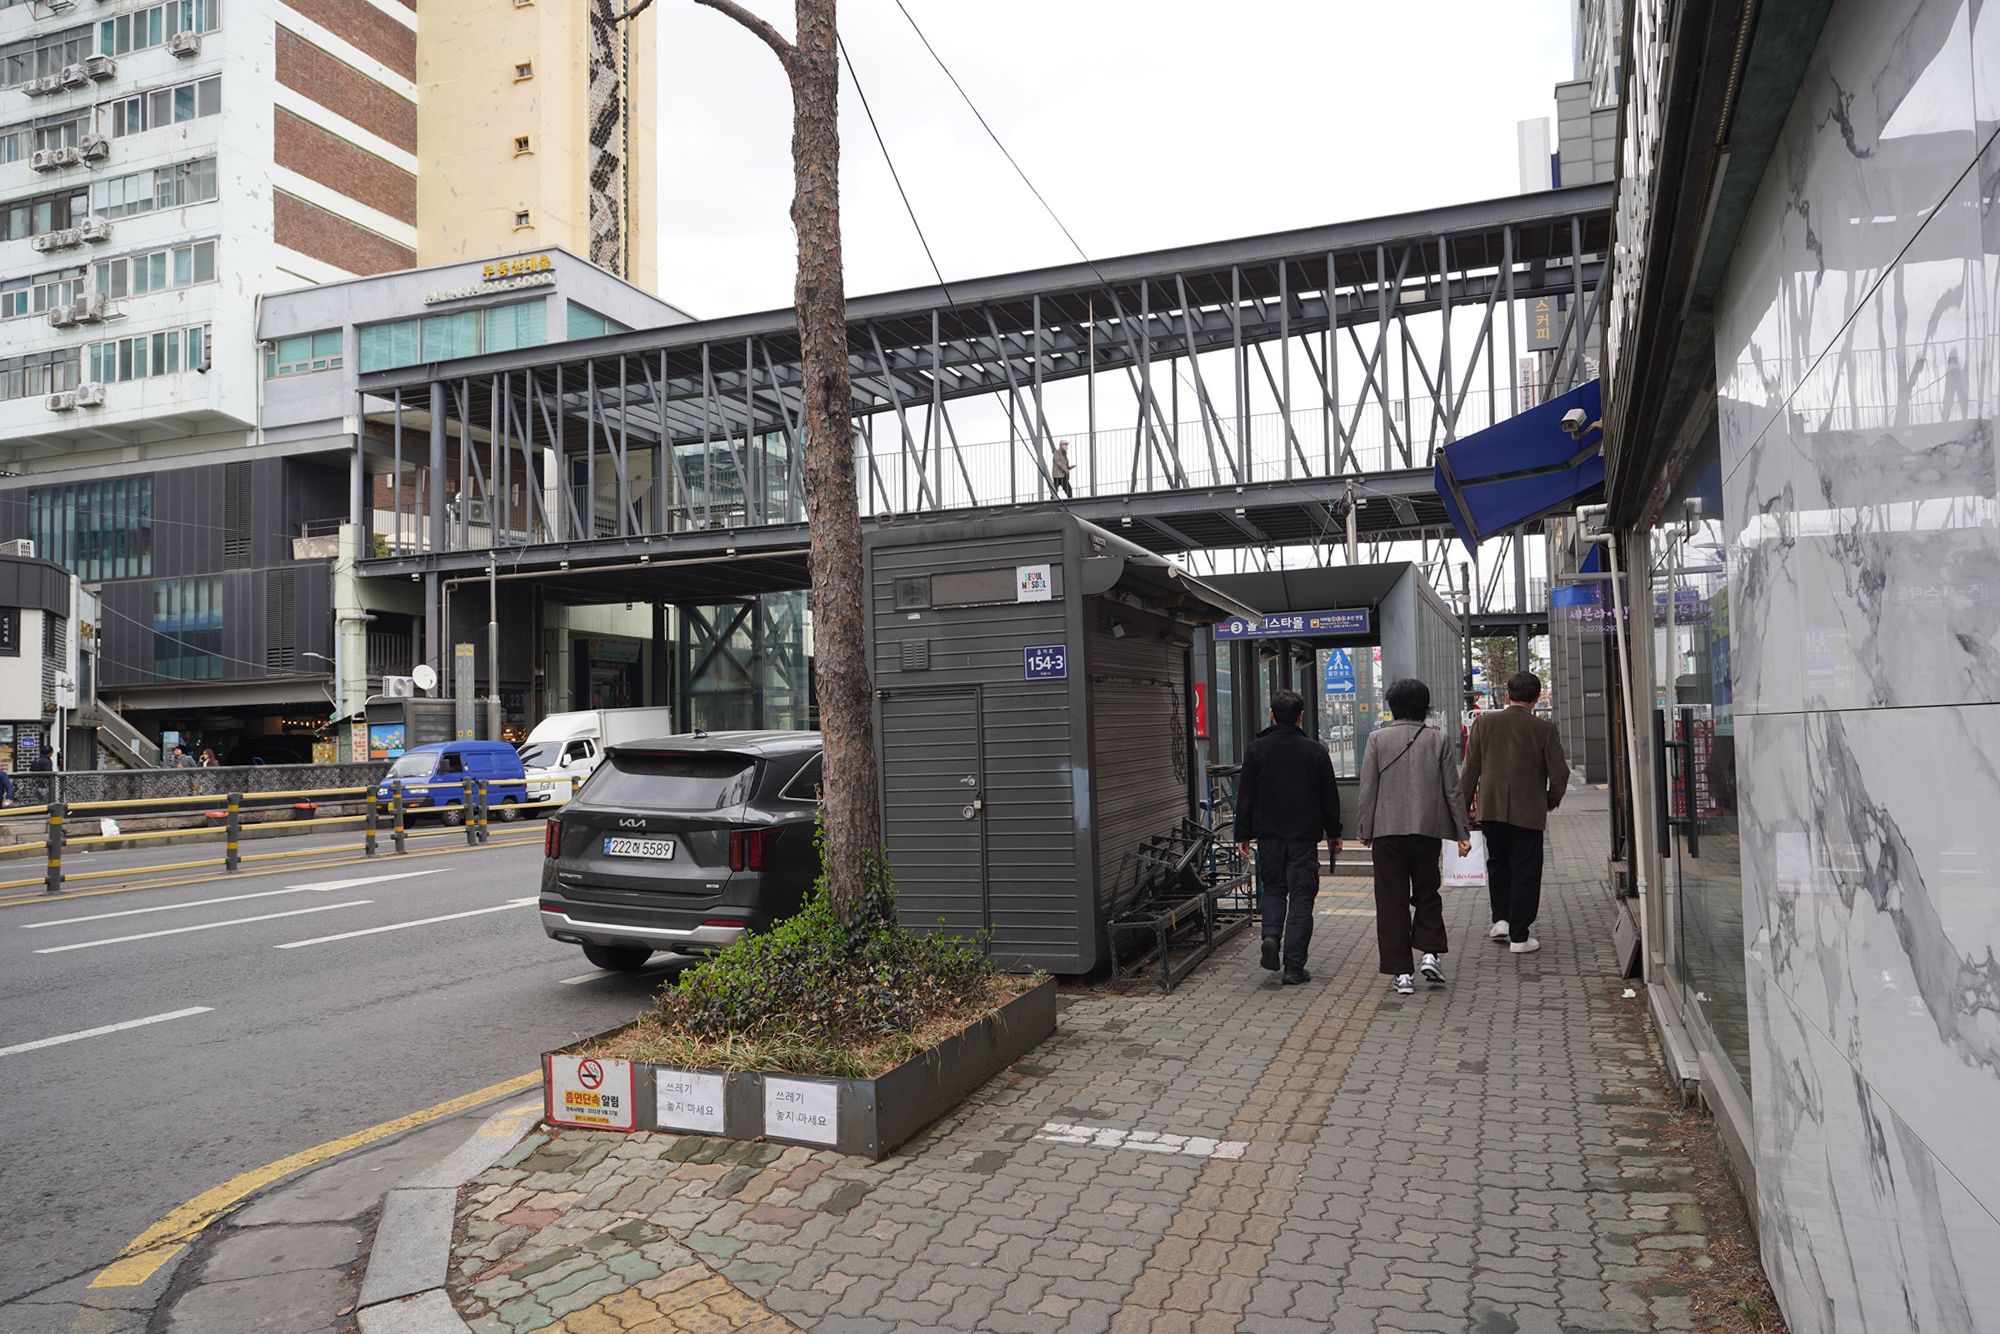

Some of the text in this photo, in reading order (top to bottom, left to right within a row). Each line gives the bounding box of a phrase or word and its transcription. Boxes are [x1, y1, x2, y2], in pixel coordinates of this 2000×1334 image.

[1535, 295, 1550, 340] 스커피
[1028, 655, 1063, 671] 154-3
[619, 818, 646, 828] KIA
[642, 842, 671, 857] 5589
[666, 1082, 692, 1095] 쓰레기
[566, 1092, 619, 1108] 흡연단속 알림
[775, 1090, 804, 1104] 쓰레기
[666, 1100, 714, 1116] 놓지 마세요
[775, 1109, 827, 1127] 놓지 마세요
